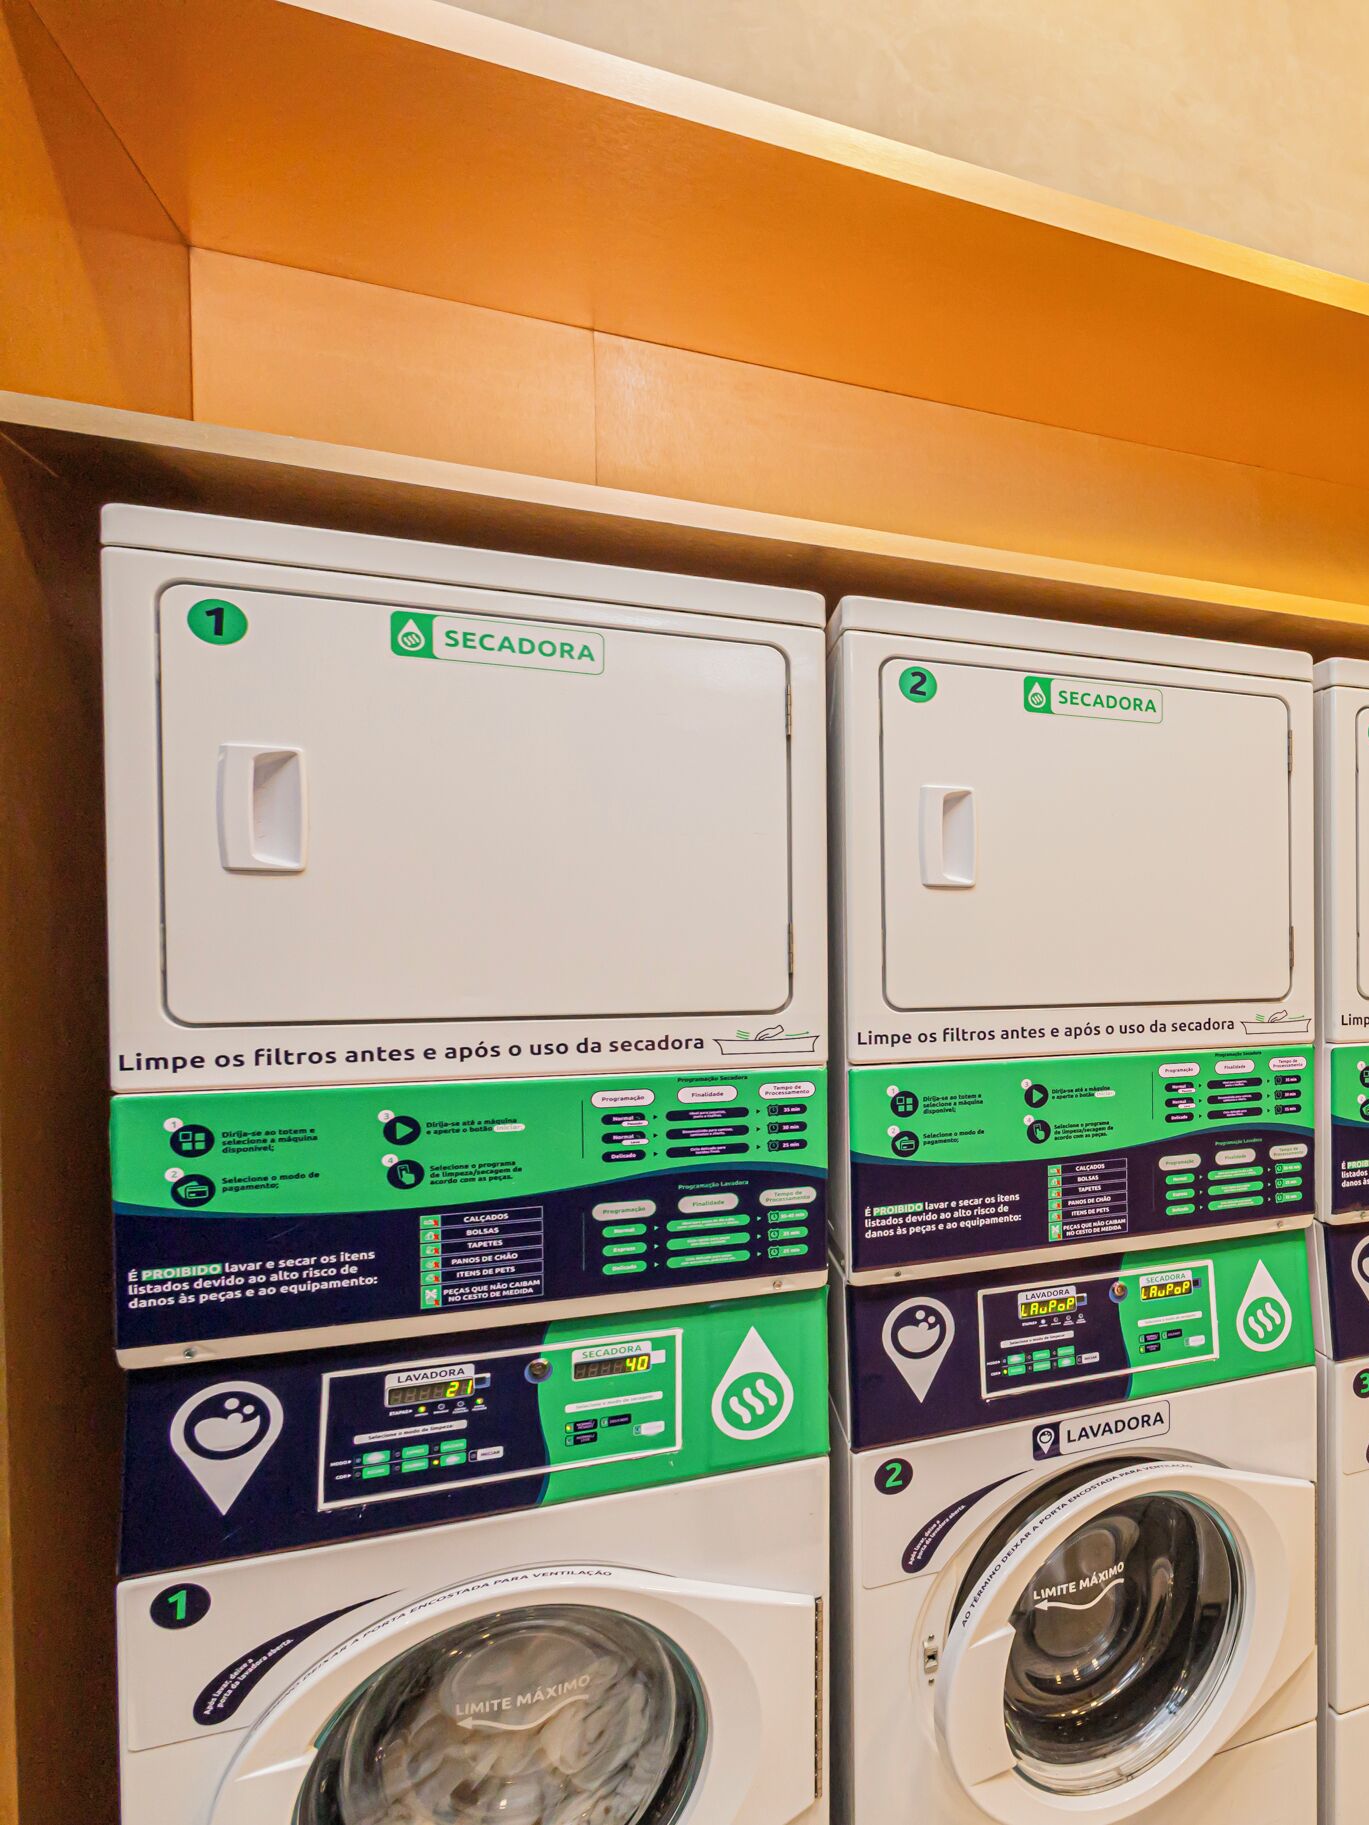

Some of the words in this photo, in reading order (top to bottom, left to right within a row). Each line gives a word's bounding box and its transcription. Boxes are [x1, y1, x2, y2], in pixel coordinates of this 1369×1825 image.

[205, 607, 224, 636] 1
[445, 630, 594, 661] SECADORA
[910, 671, 926, 696] 2
[1058, 690, 1156, 712] SECADORA
[858, 1030, 911, 1047] Limpe
[918, 1032, 937, 1043] os
[943, 1027, 995, 1042] filtros
[1001, 1026, 1045, 1039] antes
[1050, 1027, 1059, 1037] e
[1064, 1022, 1100, 1039] após
[1105, 1025, 1114, 1034] o
[1119, 1024, 1144, 1034] uso
[1149, 1019, 1166, 1032] da
[1171, 1017, 1234, 1032] secadora
[119, 1052, 205, 1073] Limpe
[215, 1054, 244, 1067] os
[255, 1048, 336, 1066] filtros
[345, 1046, 414, 1062] antes
[423, 1048, 436, 1059] e
[445, 1041, 500, 1062] após
[508, 1044, 521, 1056] o
[530, 1043, 568, 1055] uso
[576, 1037, 601, 1053] da
[609, 1035, 703, 1052] secadora
[463, 1213, 509, 1222] CALÇADOS
[865, 1206, 871, 1217] É
[873, 1203, 923, 1216] PROIBIDO
[925, 1201, 948, 1211] lavar
[959, 1198, 983, 1207] secar
[997, 1193, 1020, 1202] itens
[466, 1227, 499, 1236] BOLSAS
[467, 1239, 503, 1248] TAPETES
[128, 1269, 138, 1282] É
[142, 1265, 221, 1280] PROIBIDO
[225, 1262, 262, 1273] lavar
[278, 1257, 317, 1268] secar
[320, 1255, 336, 1264] os
[340, 1251, 375, 1262] itens
[451, 1256, 480, 1264] PANOS
[494, 1252, 518, 1260] CHÃO
[128, 1281, 189, 1295] listados
[193, 1277, 244, 1289] devido
[248, 1275, 266, 1283] ao
[269, 1271, 299, 1281] alto
[302, 1267, 336, 1278] risco
[340, 1264, 359, 1274] de
[456, 1269, 481, 1277] ITENS
[1146, 1273, 1185, 1284] SECADORA
[128, 1297, 175, 1309] danos
[178, 1293, 195, 1304] às
[199, 1290, 242, 1304] peças
[245, 1289, 254, 1297] e
[258, 1287, 276, 1295] ao
[279, 1276, 378, 1294] equipamento:
[443, 1287, 470, 1295] PEÇAS
[471, 1284, 488, 1292] QUE
[490, 1282, 507, 1290] NÃO
[509, 1280, 540, 1288] CAIBAM
[502, 1288, 533, 1296] MEDIDA
[1026, 1289, 1070, 1301] LAVADORA
[583, 1345, 642, 1359] SECADORA
[626, 1355, 649, 1372] 40
[397, 1368, 465, 1383] LAVADORA
[1067, 1412, 1164, 1443] LAVADORA
[886, 1463, 903, 1488] 2
[962, 1611, 972, 1628] AO
[970, 1564, 1002, 1609] TÉRMINO
[1001, 1531, 1032, 1563] DEIXAR
[1039, 1503, 1068, 1525] PORTA
[1068, 1475, 1119, 1504] ENCOSTADA
[1119, 1468, 1143, 1478] PARA
[1033, 1582, 1076, 1600] LIMITE
[1079, 1562, 1125, 1590] MÁXIMO
[168, 1590, 187, 1620] 1
[362, 1612, 406, 1639] PORTA
[410, 1582, 491, 1614] ENCOSTADA
[494, 1573, 529, 1586] PARA
[532, 1569, 613, 1579] VENTILAÇÃO
[456, 1697, 511, 1716] LIMITE
[516, 1674, 591, 1706] MÁXIMO
